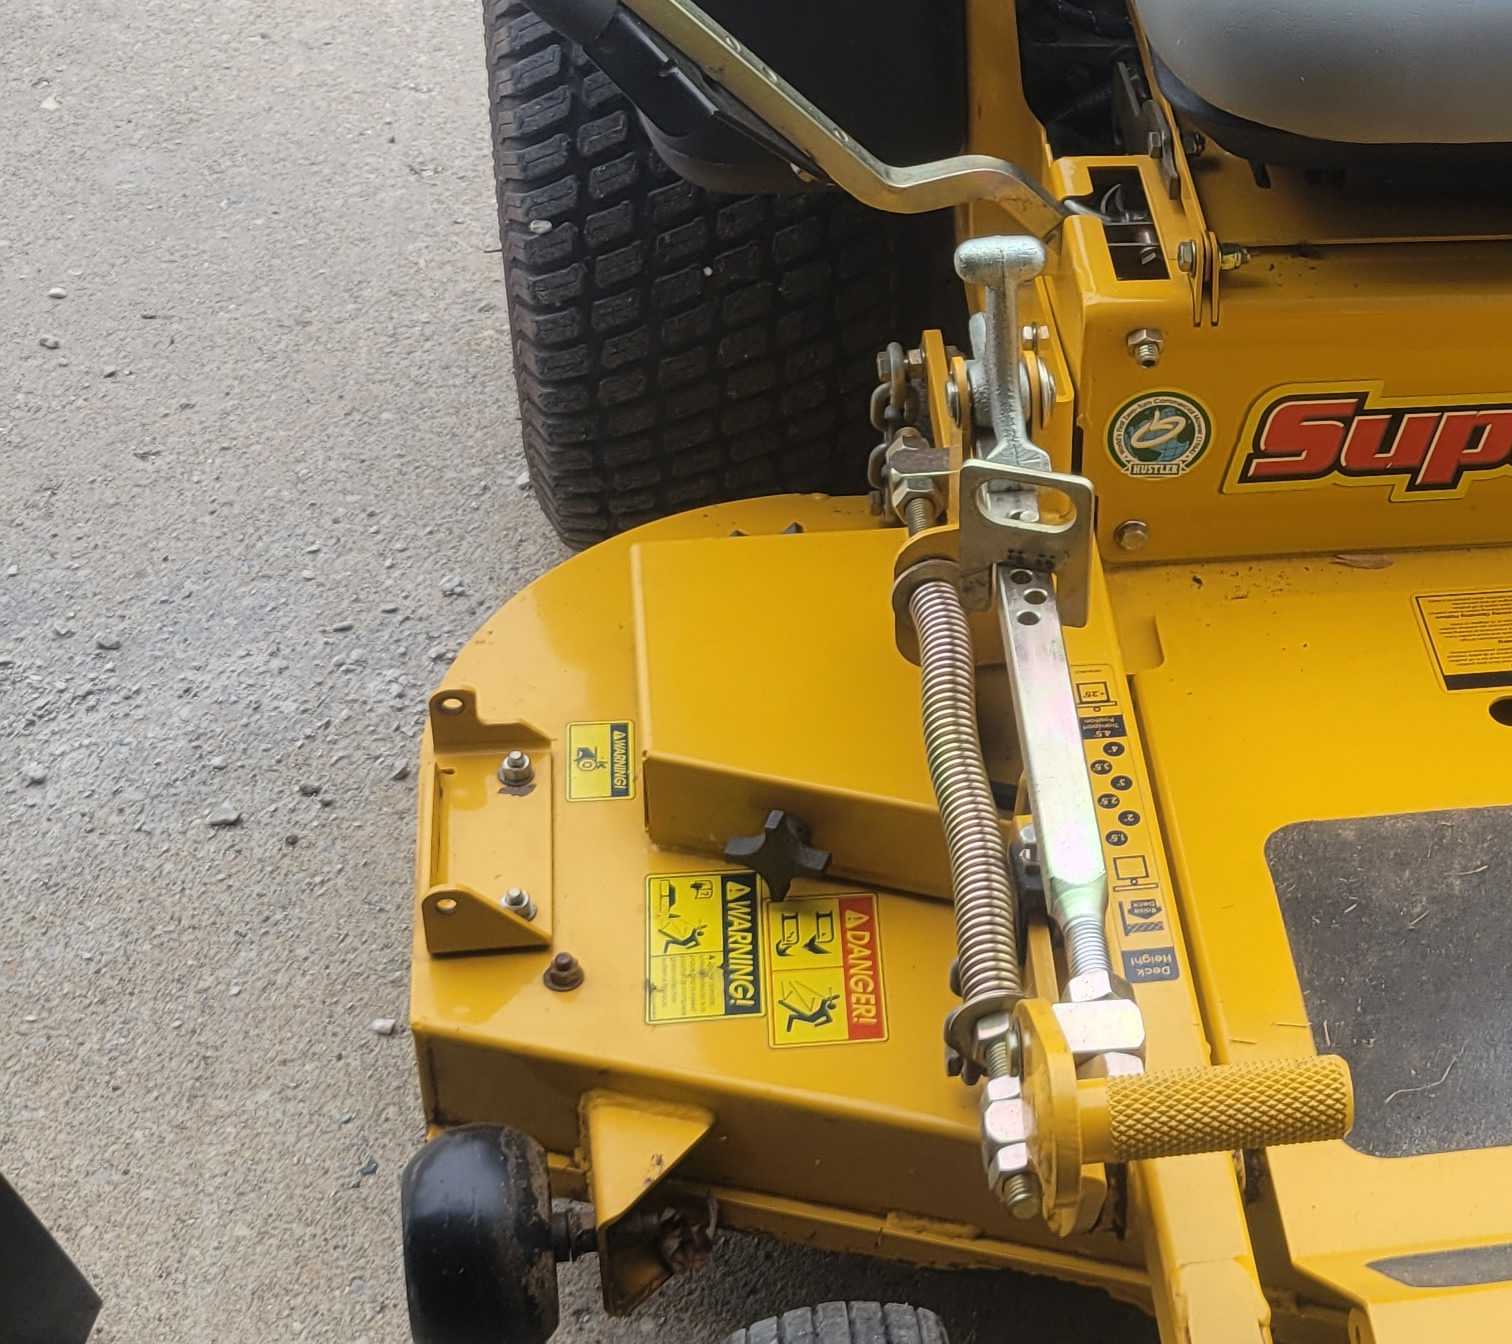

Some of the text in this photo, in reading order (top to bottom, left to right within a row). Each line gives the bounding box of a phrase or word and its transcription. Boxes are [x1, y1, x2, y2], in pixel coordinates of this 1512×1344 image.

[1132, 464, 1179, 474] HUSTLER
[613, 740, 627, 789] WARNING!
[726, 903, 756, 1006] WARNING!
[1130, 954, 1172, 965] Height
[847, 931, 877, 1025] DANGER!
[1136, 966, 1170, 976] Deck
